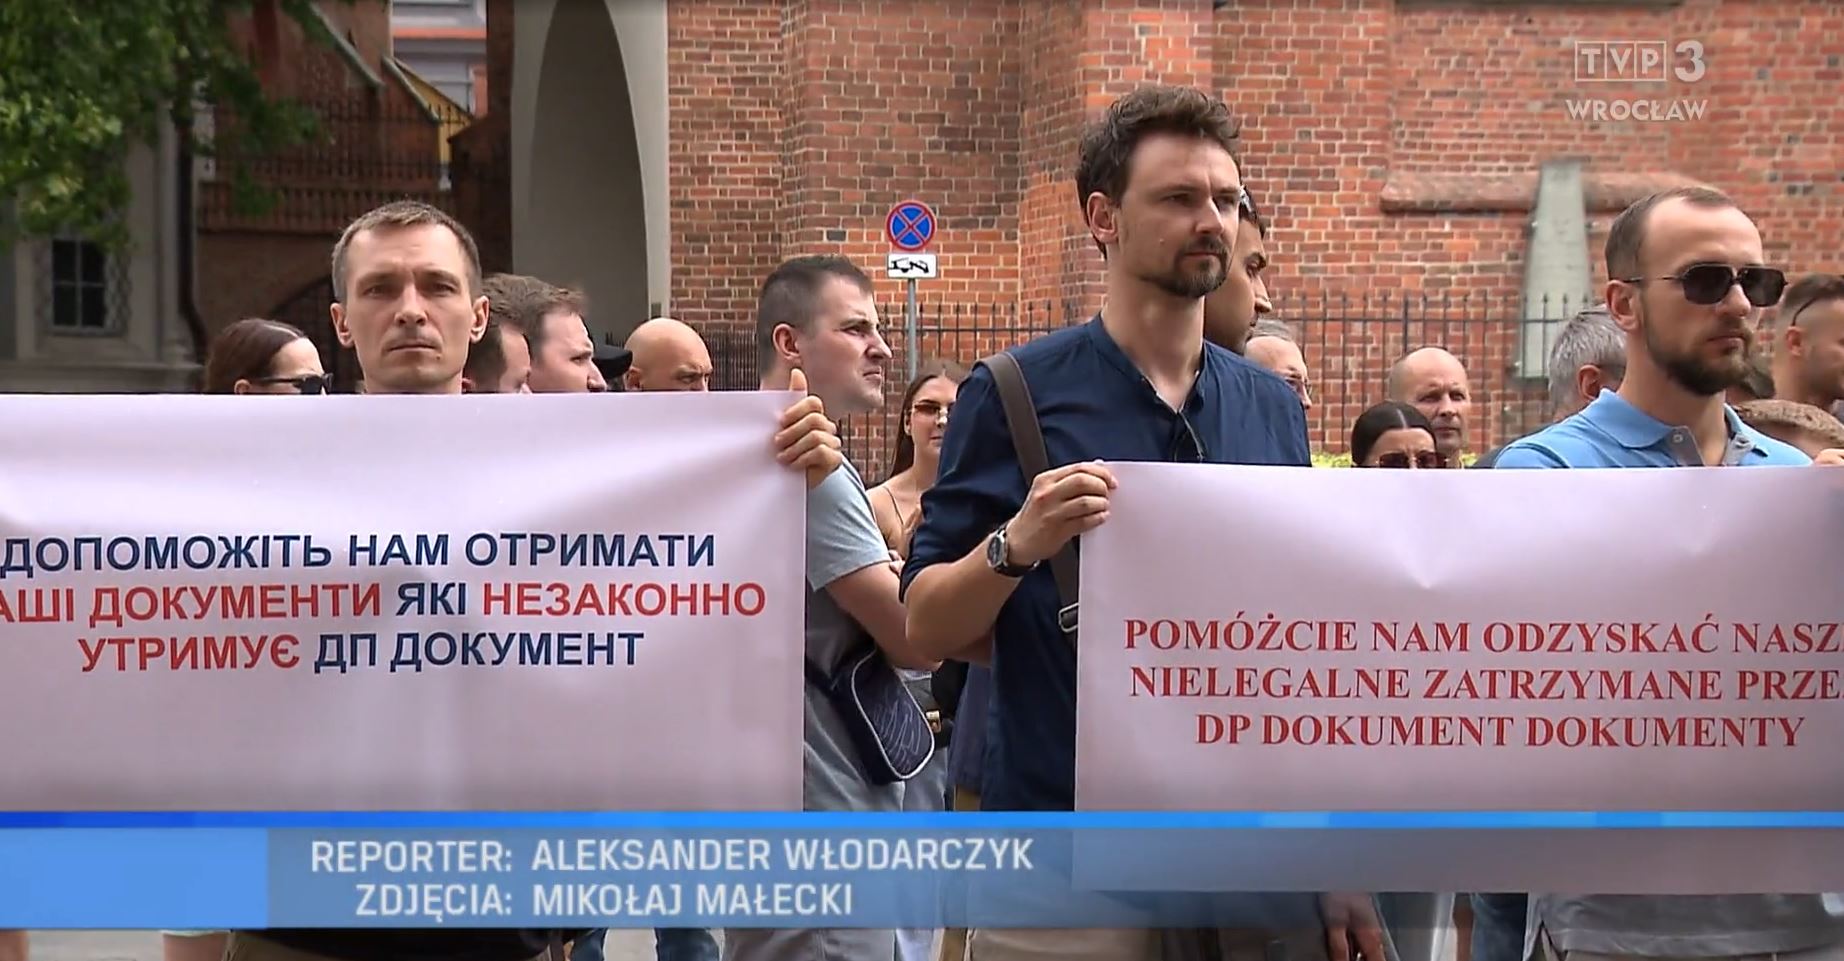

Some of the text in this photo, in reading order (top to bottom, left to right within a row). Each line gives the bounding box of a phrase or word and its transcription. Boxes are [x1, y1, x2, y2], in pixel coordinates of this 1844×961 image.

[0, 532, 715, 578] ДОПОМОЖІТЬ НАМ ОТРИМАТИ
[89, 583, 380, 628] ДОКУМЕНТИ
[395, 582, 466, 616] ЯКІ
[483, 582, 766, 617] НЕЗАКОННО
[78, 632, 644, 673] УТРИМУЄ ДП ДОКУМЕНТ
[1124, 611, 1844, 653] POMÓŻCIE NAM ODZYSKAĆ NASZ
[1130, 666, 1844, 700] NIELEGALNE ZATRZYMANE PRZE
[1195, 714, 1805, 748] DP DOKUMENT DOKUMENTY
